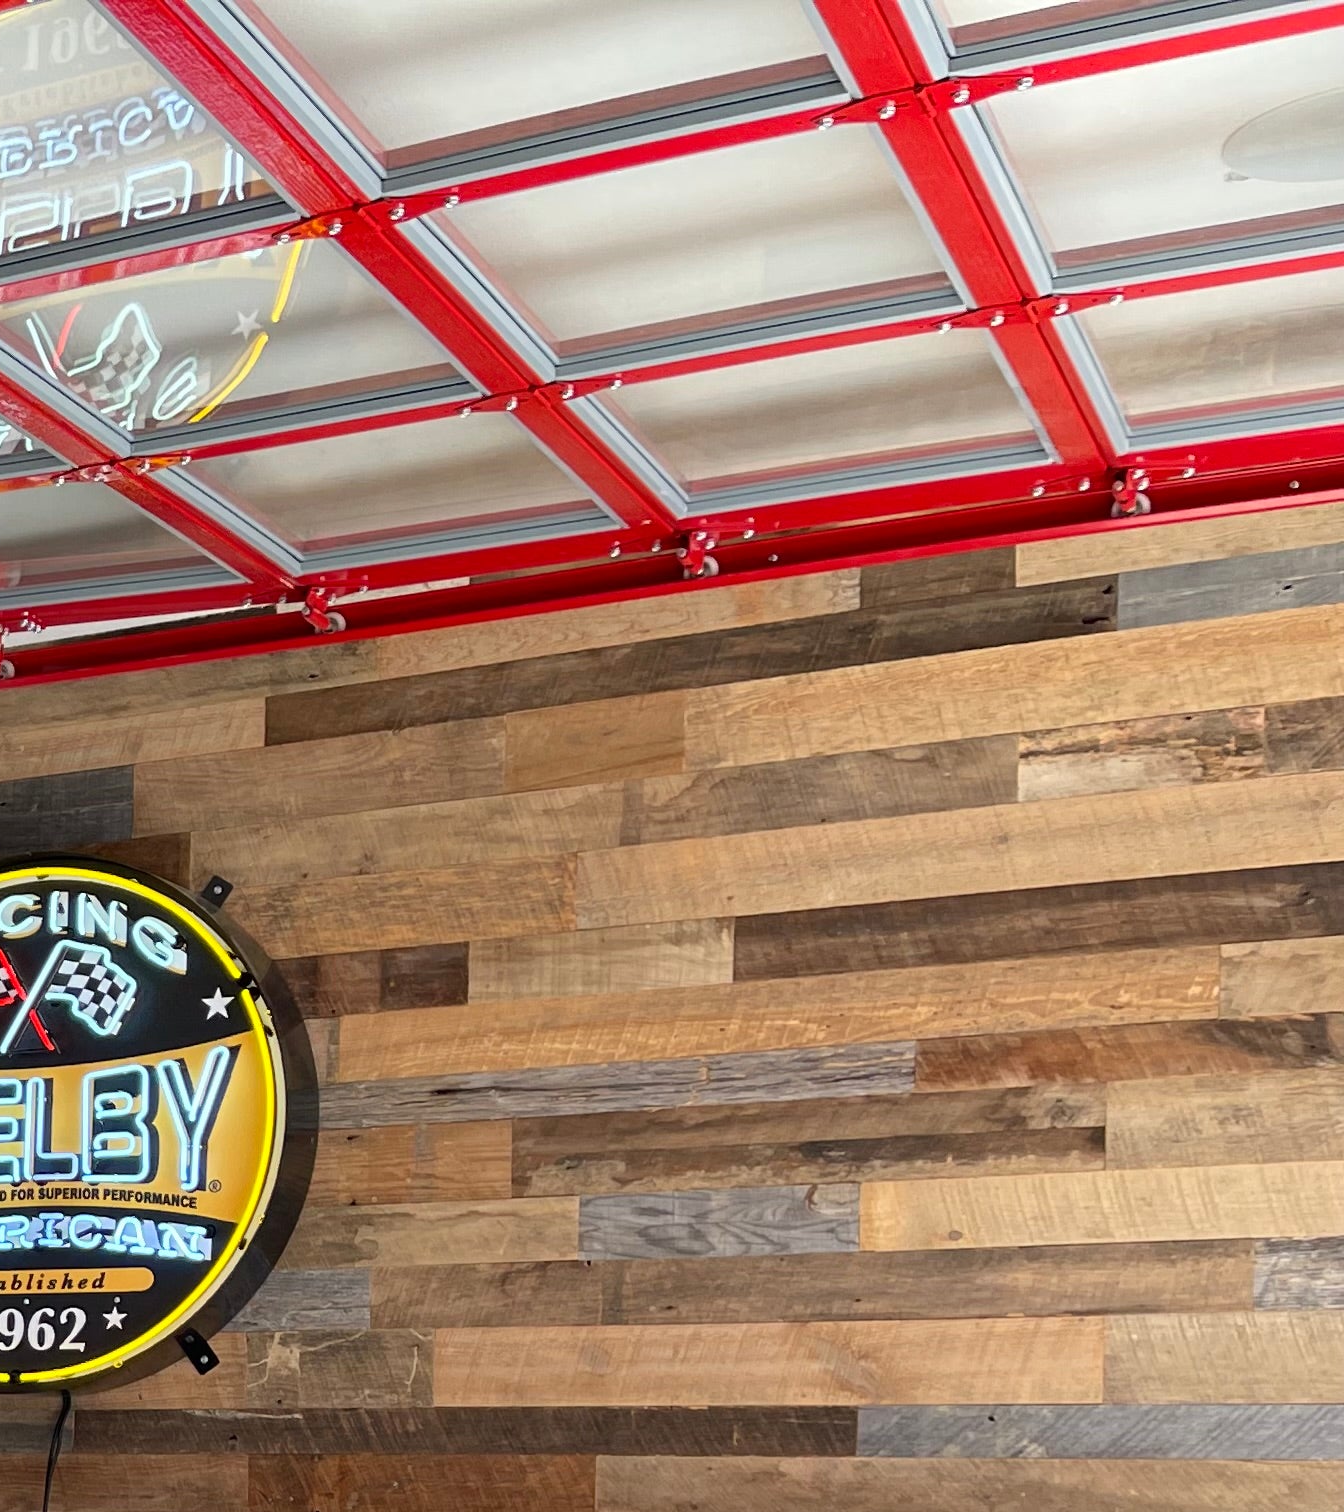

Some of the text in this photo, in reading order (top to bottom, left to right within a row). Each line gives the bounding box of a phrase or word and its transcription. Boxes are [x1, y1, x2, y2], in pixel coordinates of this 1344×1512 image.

[10, 1188, 35, 1201] FOR
[37, 1187, 100, 1201] SUPERIOR
[103, 1187, 198, 1210] PERFORMANCE
